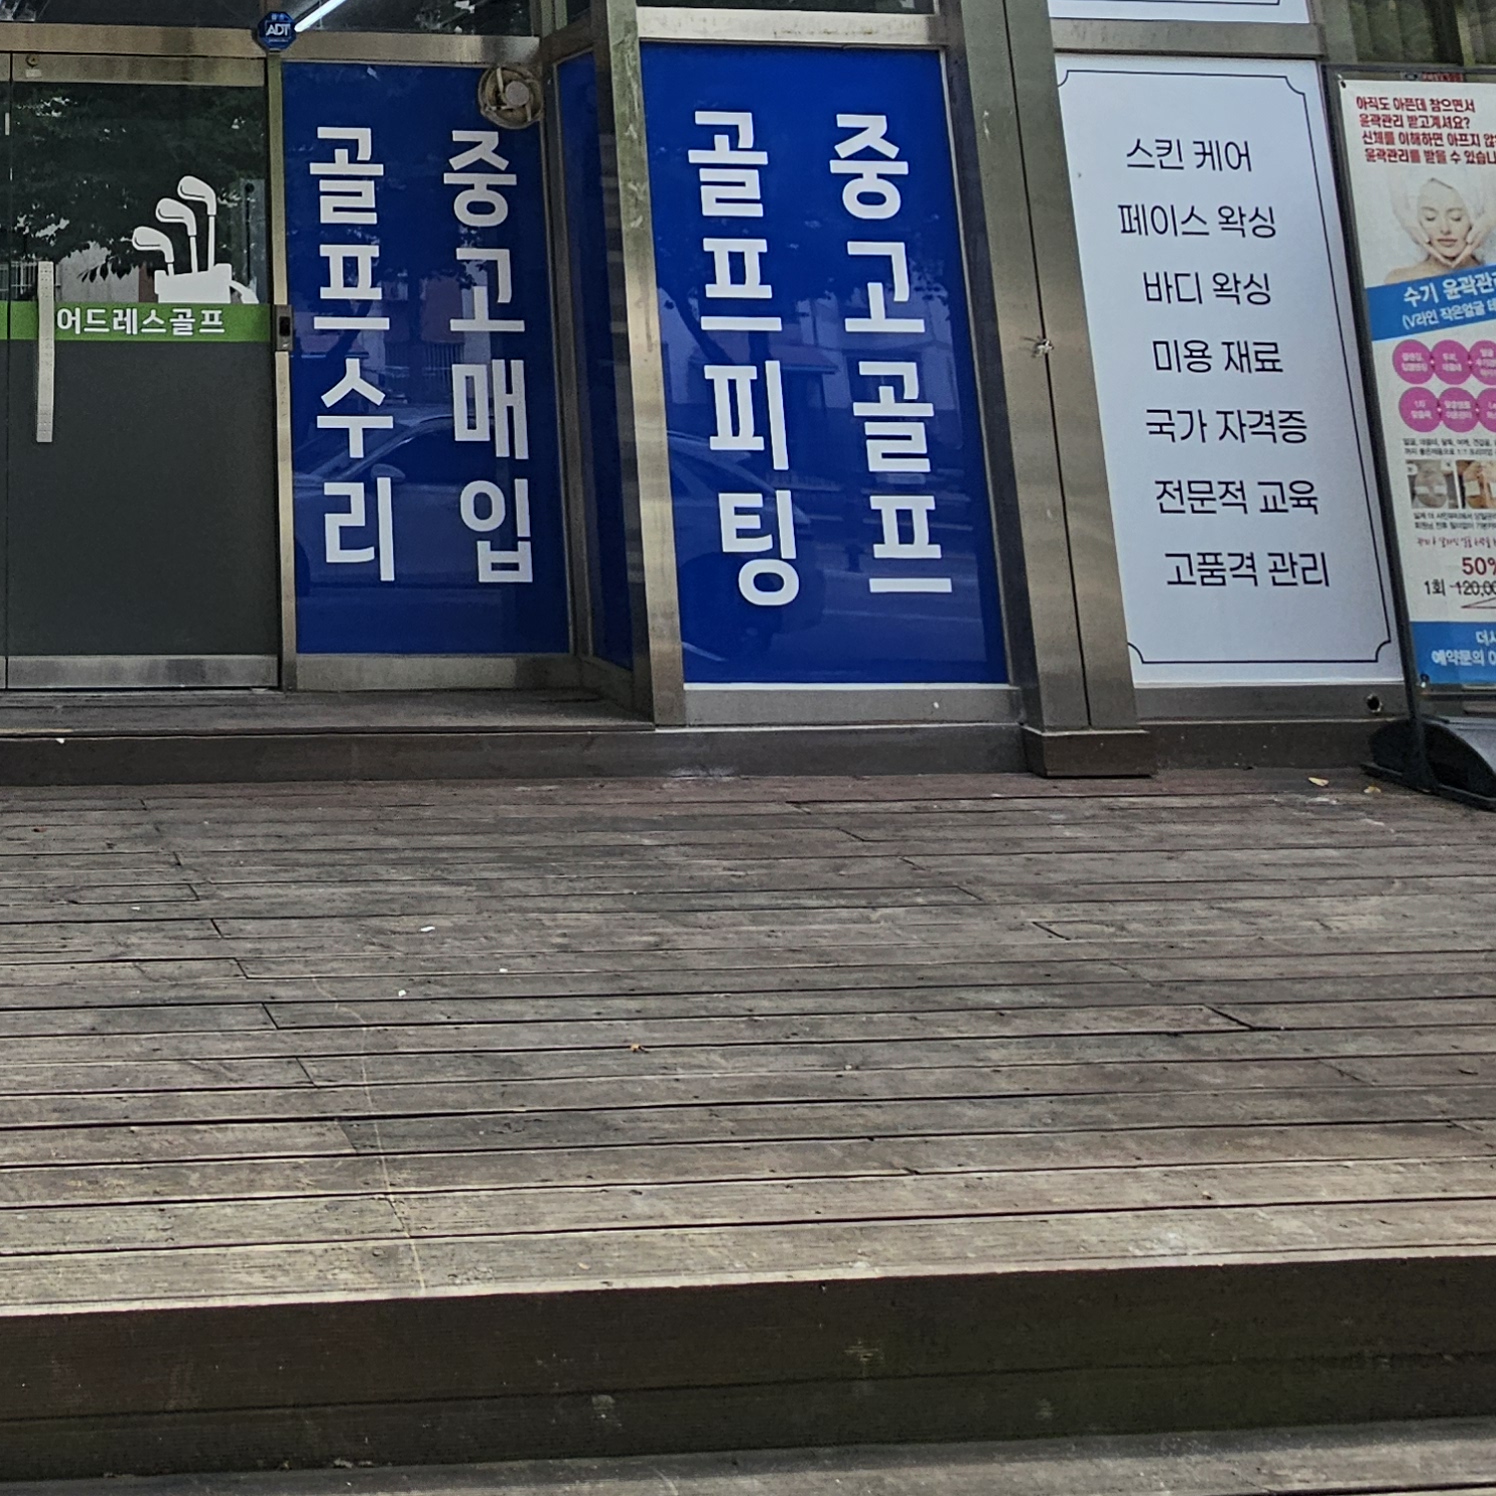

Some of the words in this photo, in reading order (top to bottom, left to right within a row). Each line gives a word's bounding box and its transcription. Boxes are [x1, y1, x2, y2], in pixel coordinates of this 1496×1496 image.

[265, 23, 291, 36] ADT
[1356, 96, 1391, 111] 아직도
[1126, 138, 1184, 171] 스킨
[1192, 139, 1253, 172] 케어
[1447, 133, 1481, 147] 아프지
[1450, 150, 1462, 164] 수
[1118, 204, 1210, 237] 페이스
[1217, 205, 1277, 239] 왁싱
[1143, 271, 1204, 305] 바디
[1211, 272, 1272, 306] 왁싱
[1403, 282, 1440, 308] 수기
[56, 306, 226, 336] 어드레스골프
[308, 125, 396, 583] 골프수리
[442, 129, 534, 584] 중고매입
[687, 110, 801, 608] 골프피팅
[829, 112, 953, 595] 중고골프
[1152, 339, 1213, 374] 미용
[1221, 340, 1284, 374] 재료
[1145, 409, 1208, 443] 국가
[1215, 410, 1308, 444] 자격증
[1154, 479, 1248, 515] 전문적
[1257, 480, 1320, 515] 교육
[1164, 552, 1259, 588] 고품격
[1267, 552, 1331, 588] 관리
[1423, 578, 1446, 597] 1회
[1431, 649, 1485, 667] 예약문의
